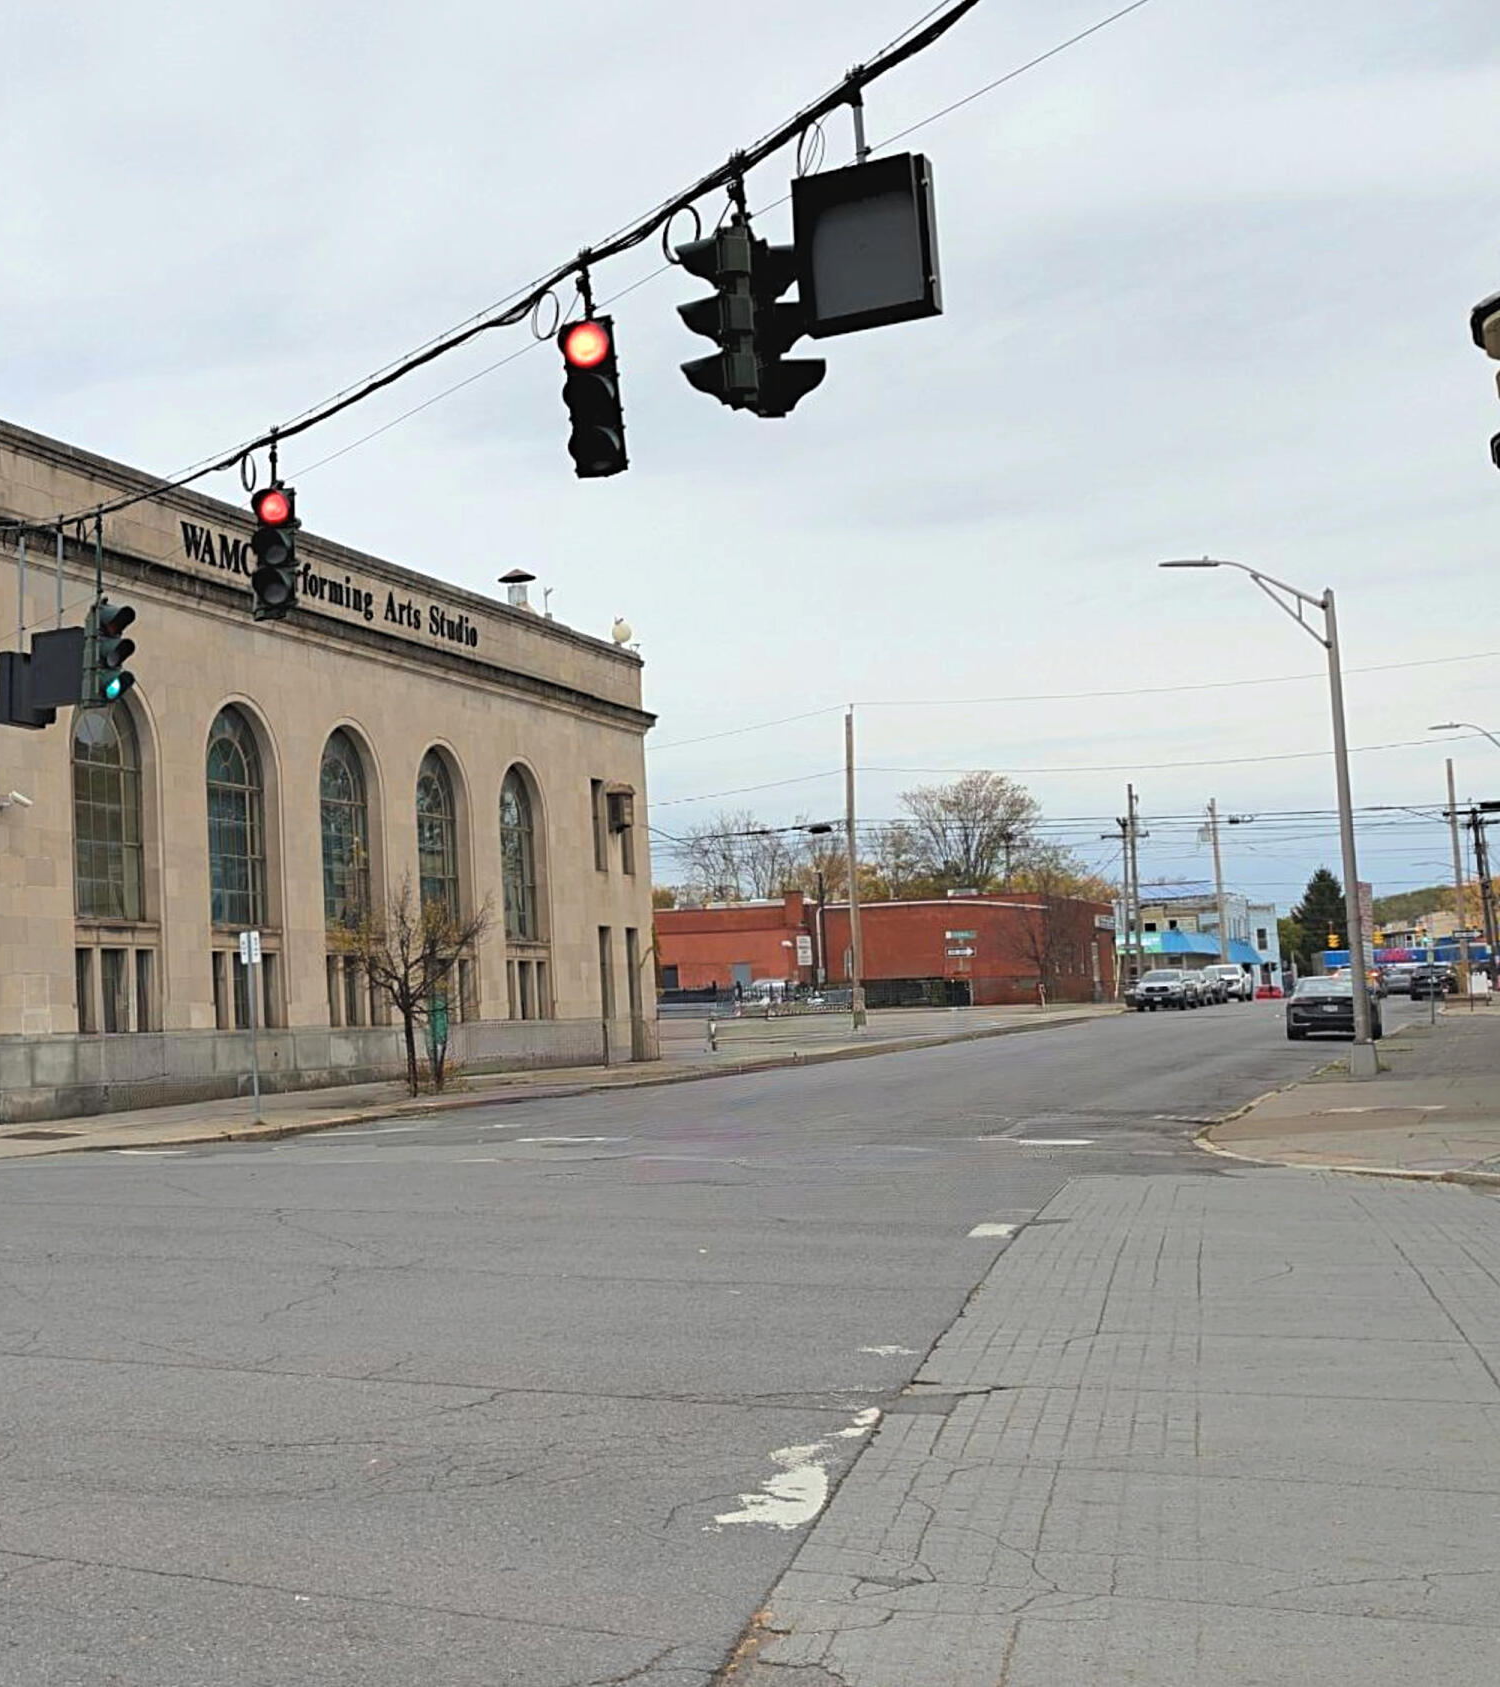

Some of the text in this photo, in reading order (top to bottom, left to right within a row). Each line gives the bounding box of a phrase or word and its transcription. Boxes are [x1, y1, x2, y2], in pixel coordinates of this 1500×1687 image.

[296, 562, 374, 621] rforming
[384, 591, 421, 630] Arts
[429, 605, 478, 647] Studio
